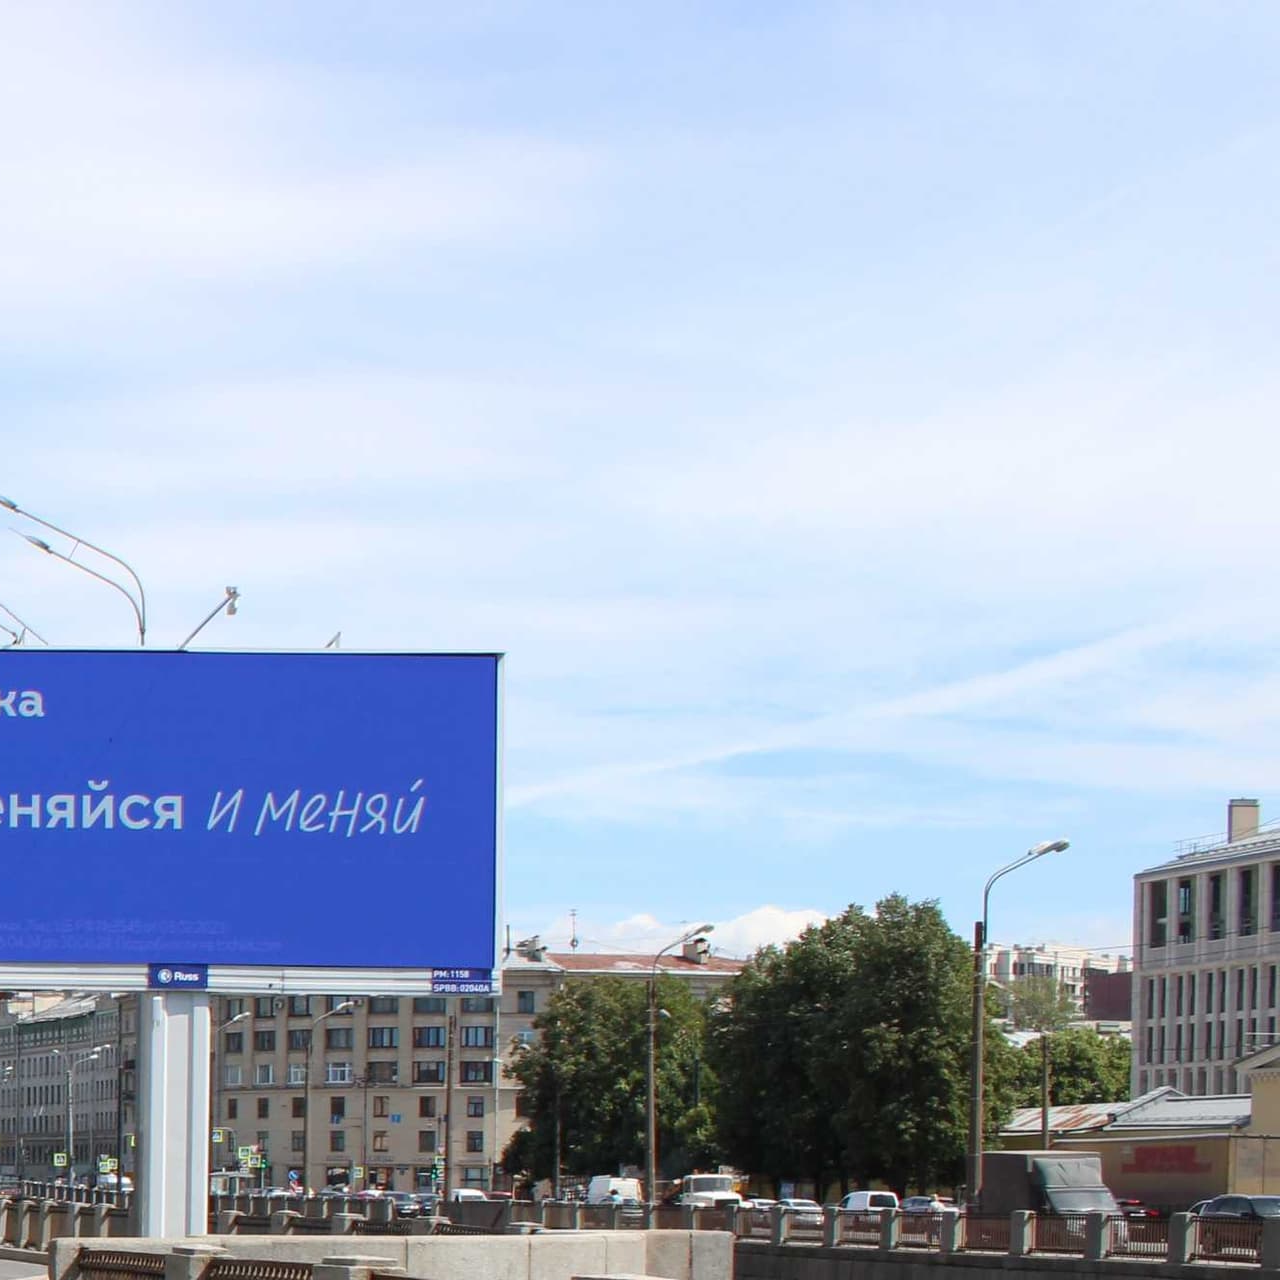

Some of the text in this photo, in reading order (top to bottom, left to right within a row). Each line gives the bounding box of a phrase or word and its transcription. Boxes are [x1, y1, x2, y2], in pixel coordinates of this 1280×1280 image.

[206, 789, 243, 832] и
[254, 779, 425, 837] меняй
[174, 971, 200, 981] Russ
